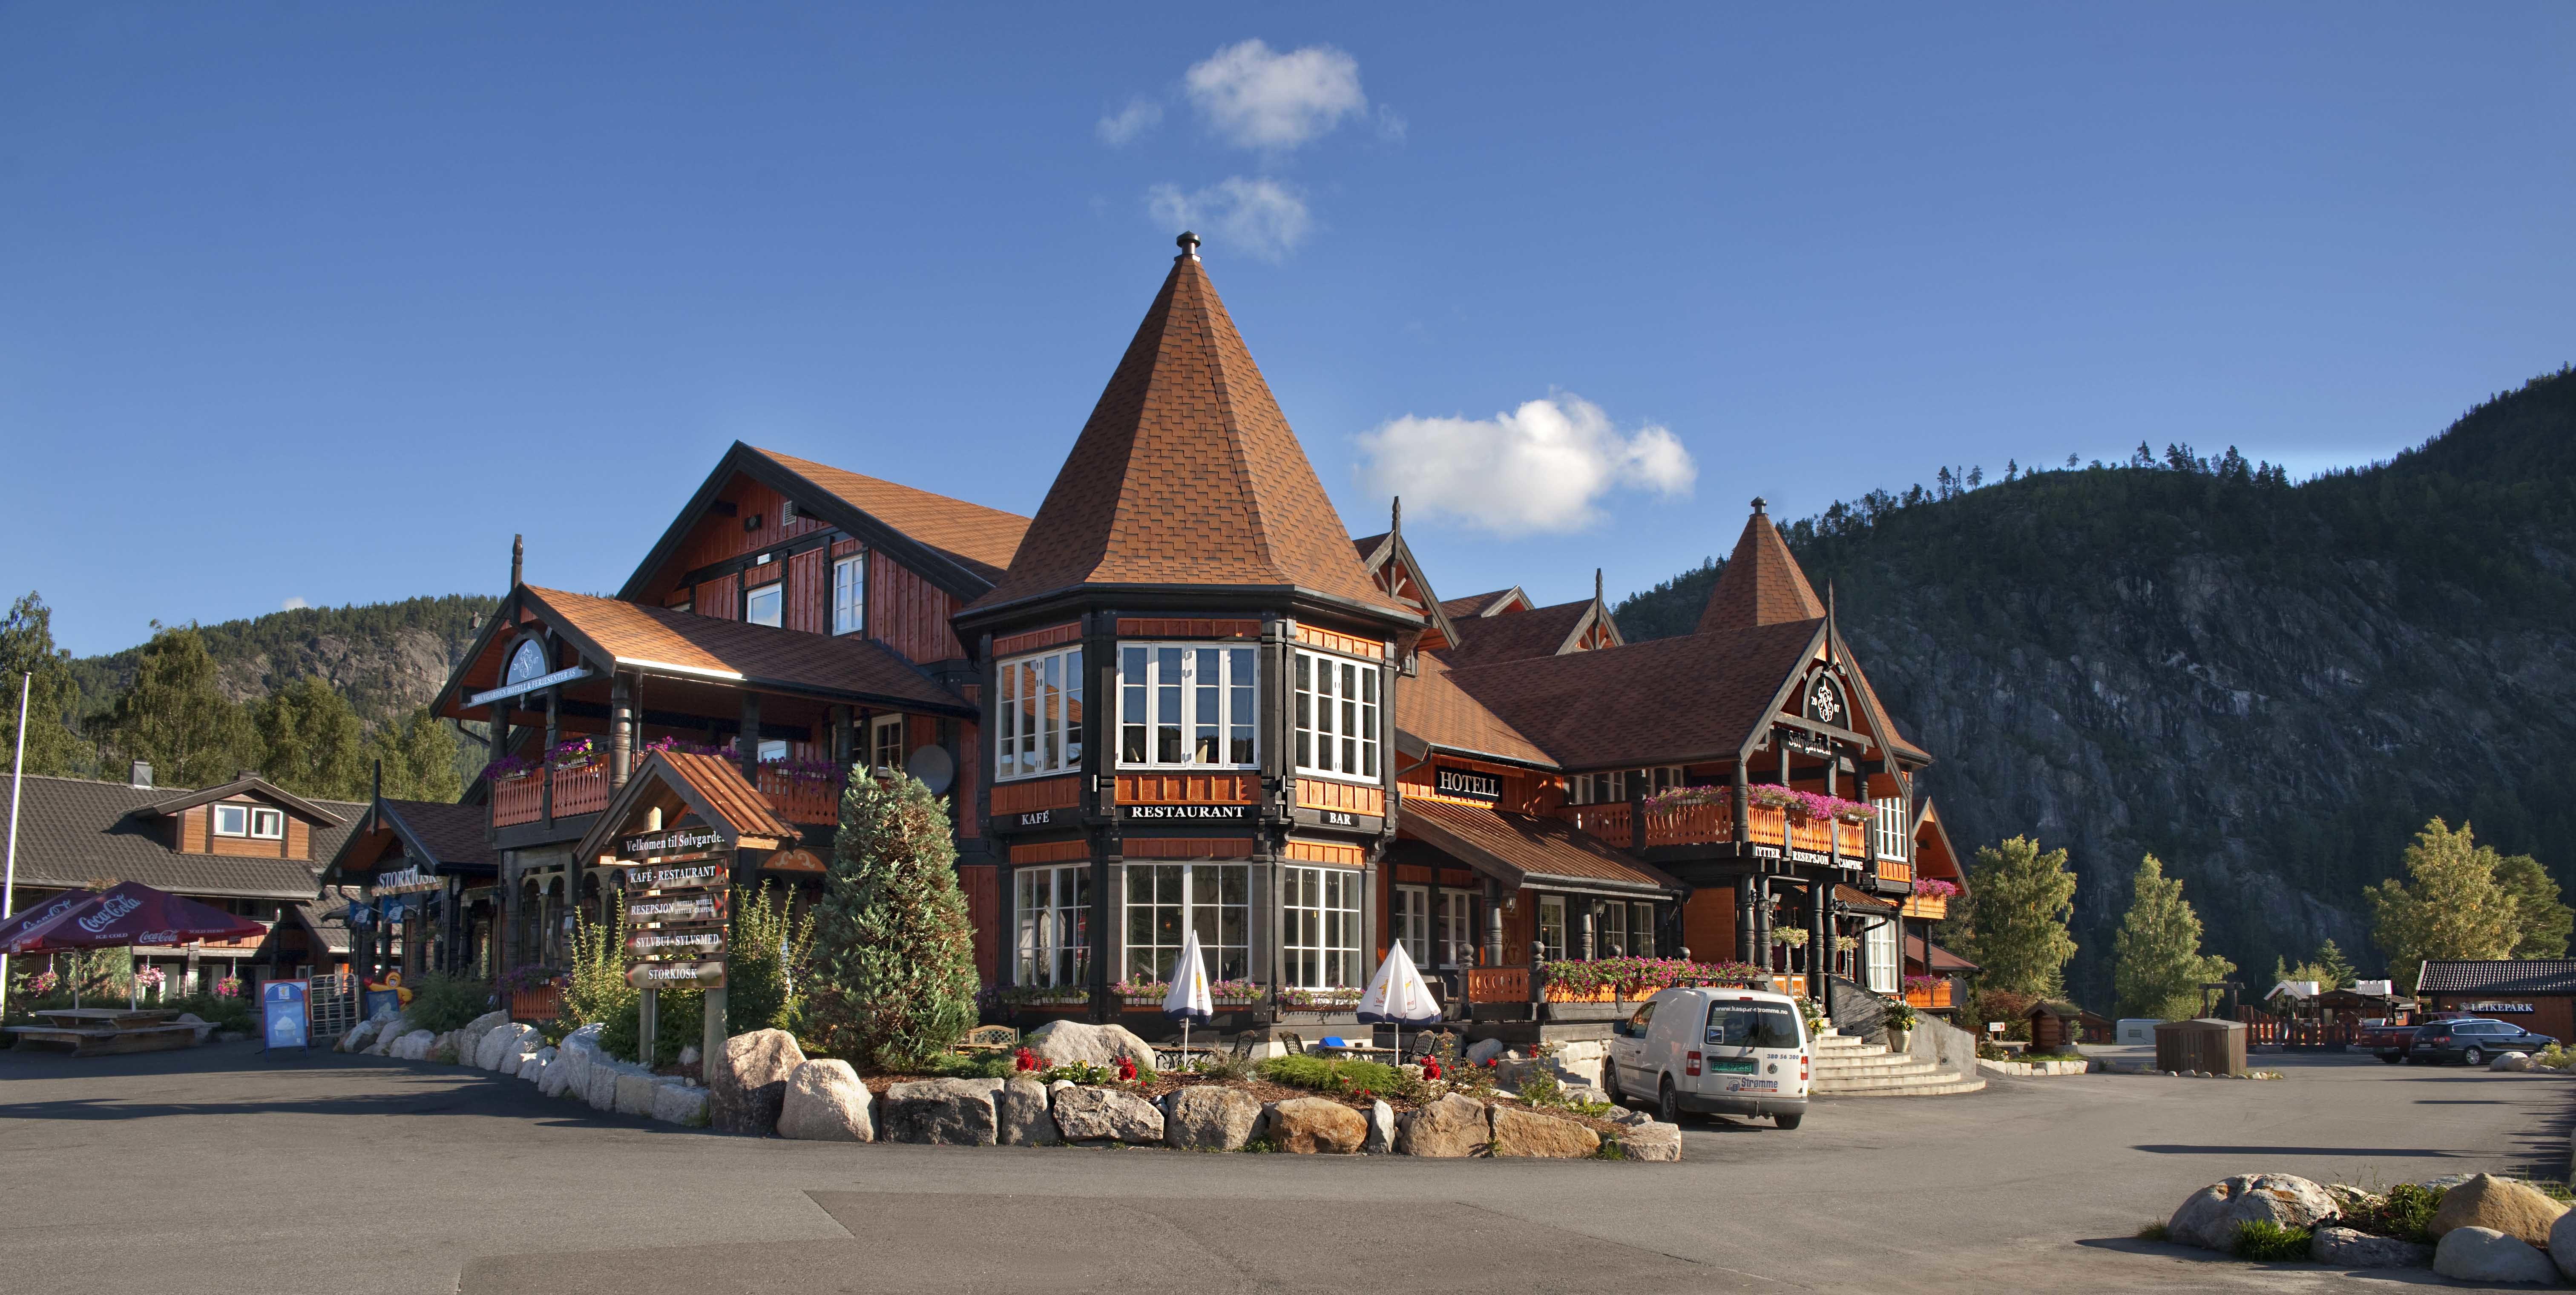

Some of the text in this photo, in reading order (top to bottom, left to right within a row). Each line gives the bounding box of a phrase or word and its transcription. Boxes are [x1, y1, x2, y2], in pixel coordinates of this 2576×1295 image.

[507, 684, 527, 695] HOTELL
[532, 671, 567, 688] FERIESENTER
[568, 669, 575, 678] AS
[1811, 696, 1840, 712] 20 07
[1440, 771, 1499, 797] HOTELL
[1022, 810, 1049, 825] KAFÉ
[1132, 806, 1244, 817] RESTAURANT
[1329, 812, 1351, 825] BAR
[627, 838, 666, 852] Velkomen
[668, 835, 677, 847] til
[1792, 851, 1829, 865] RESEPSJON
[1838, 858, 1863, 870] CAMPING
[630, 869, 652, 883] KAFÉ
[658, 866, 716, 880] RESTAURANT
[78, 893, 141, 932] Coca-Cola
[631, 903, 674, 915] RESEPSJON
[139, 930, 179, 943] Coca-Cola
[636, 937, 670, 947] SYLVBUI
[676, 934, 719, 946] SYLVSMED
[648, 969, 697, 979] STORKIOSK
[1742, 1077, 1778, 1088] Strømme
